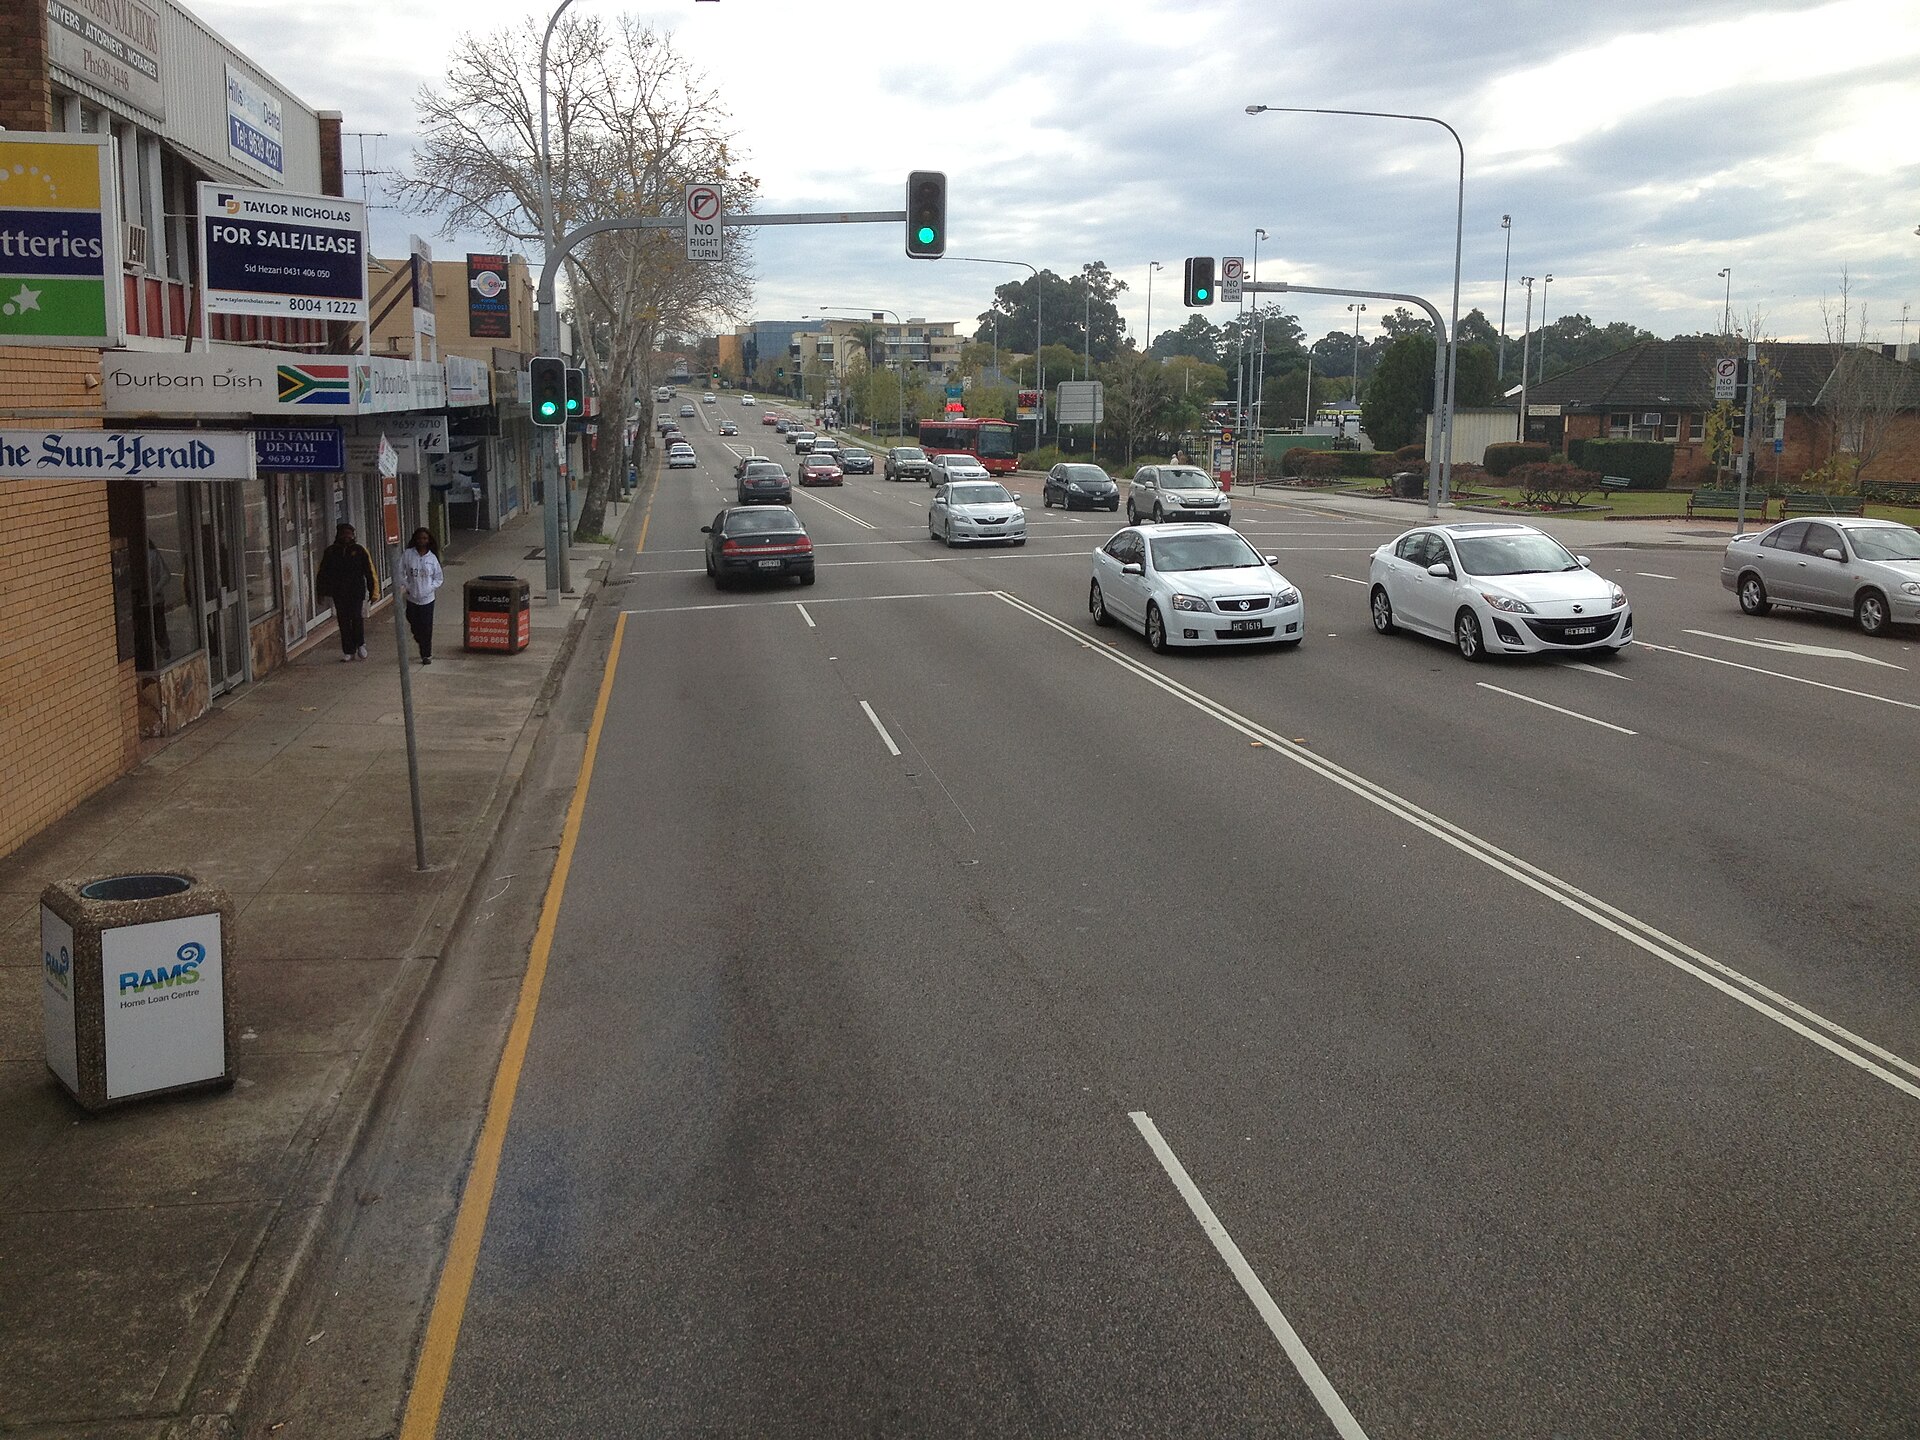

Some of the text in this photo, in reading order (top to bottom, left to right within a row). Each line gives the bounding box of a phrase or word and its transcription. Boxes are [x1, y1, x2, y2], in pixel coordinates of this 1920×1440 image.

[47, 0, 80, 31] AWYERS
[85, 22, 123, 58] ATTORNEYS
[127, 48, 157, 78] NOTARIES
[228, 75, 281, 132] Hills Dental
[243, 201, 351, 222] TAYLOR NICHOLAS
[694, 223, 714, 236] NO
[0, 229, 102, 258] tteries
[212, 225, 356, 255] FOR SALE/LEASE
[690, 238, 718, 247] RIGHT
[692, 249, 718, 258] TURN
[245, 263, 331, 279] Sid Hezari 0431 406 050
[289, 298, 357, 314] 8004 1222
[110, 368, 263, 388] Durban Dish
[418, 419, 441, 429] 6710
[288, 431, 334, 442] FAMILY
[36, 434, 215, 475] Sun-Herald
[266, 442, 317, 453] DENTAL
[268, 455, 316, 464] 9639 4237
[119, 961, 201, 996] RAMS
[119, 989, 200, 1009] Home Loan Centre
